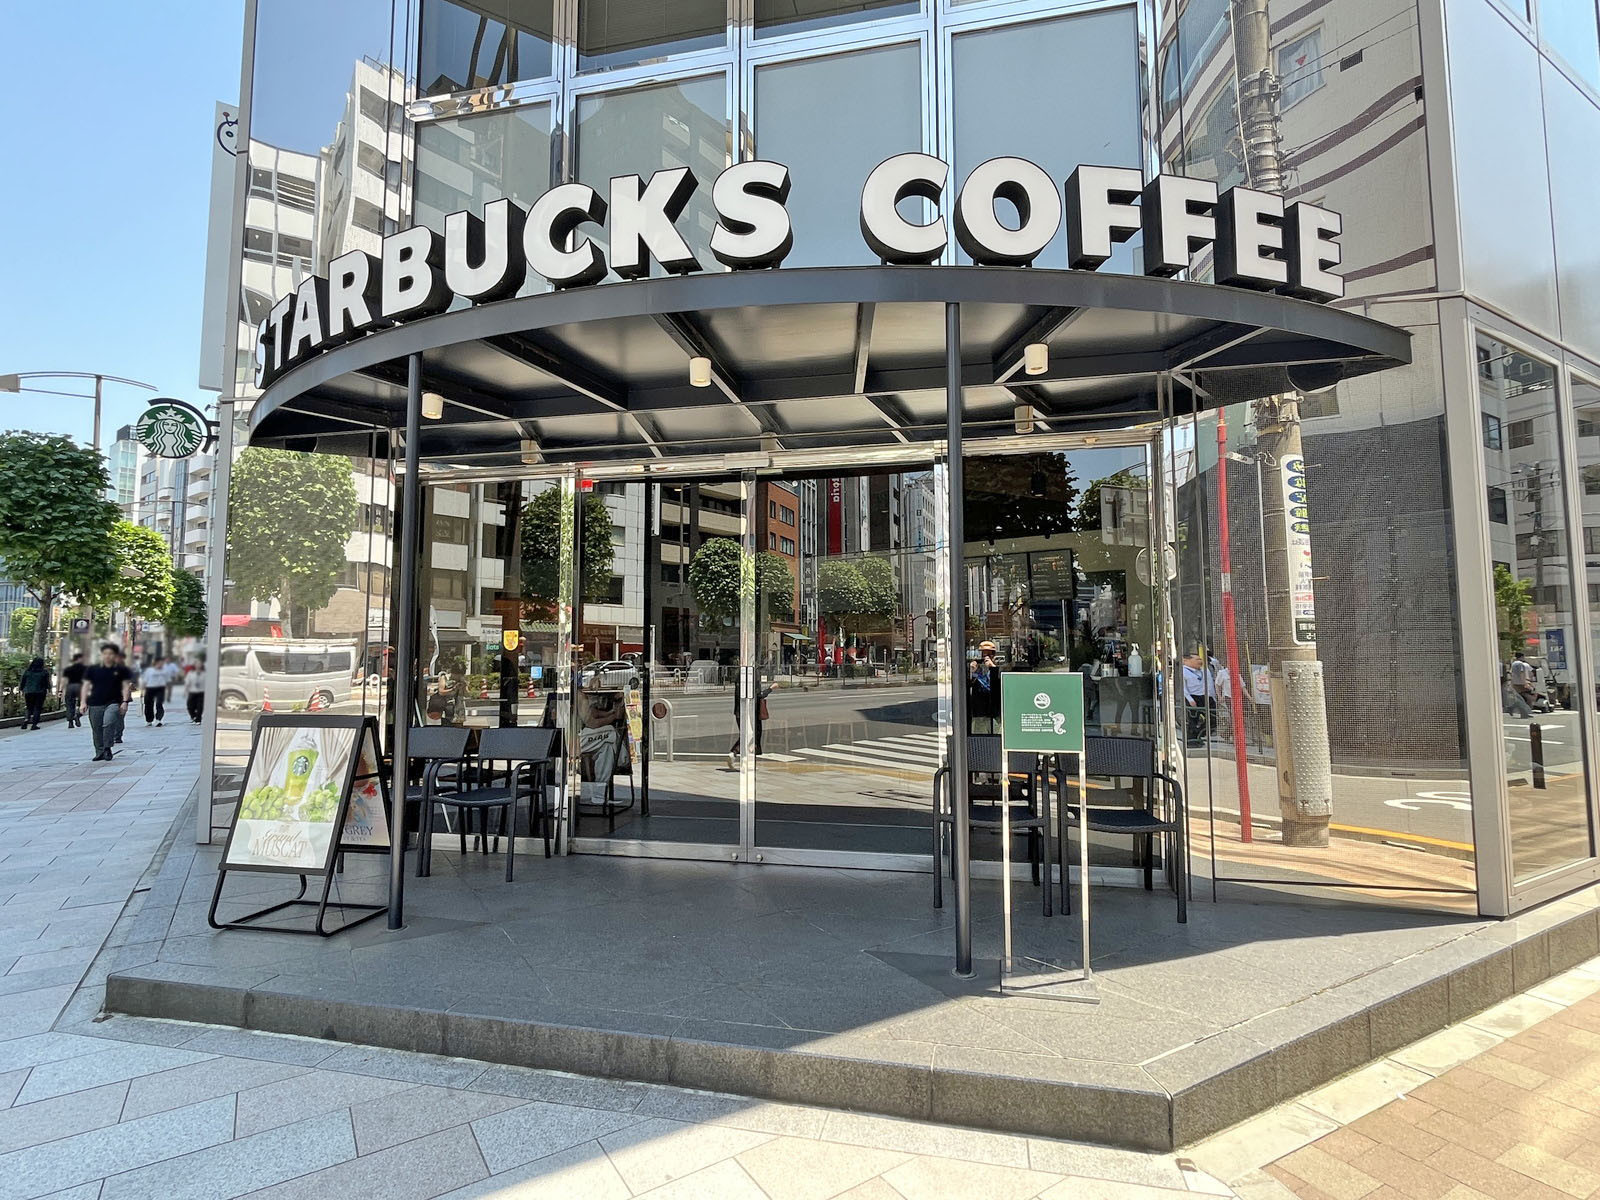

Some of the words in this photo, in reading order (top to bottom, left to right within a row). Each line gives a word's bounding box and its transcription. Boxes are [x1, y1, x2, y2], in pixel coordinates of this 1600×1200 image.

[255, 161, 792, 388] STARBUCKS
[861, 153, 1345, 300] COFFEE
[252, 839, 306, 858] MUSCAT
